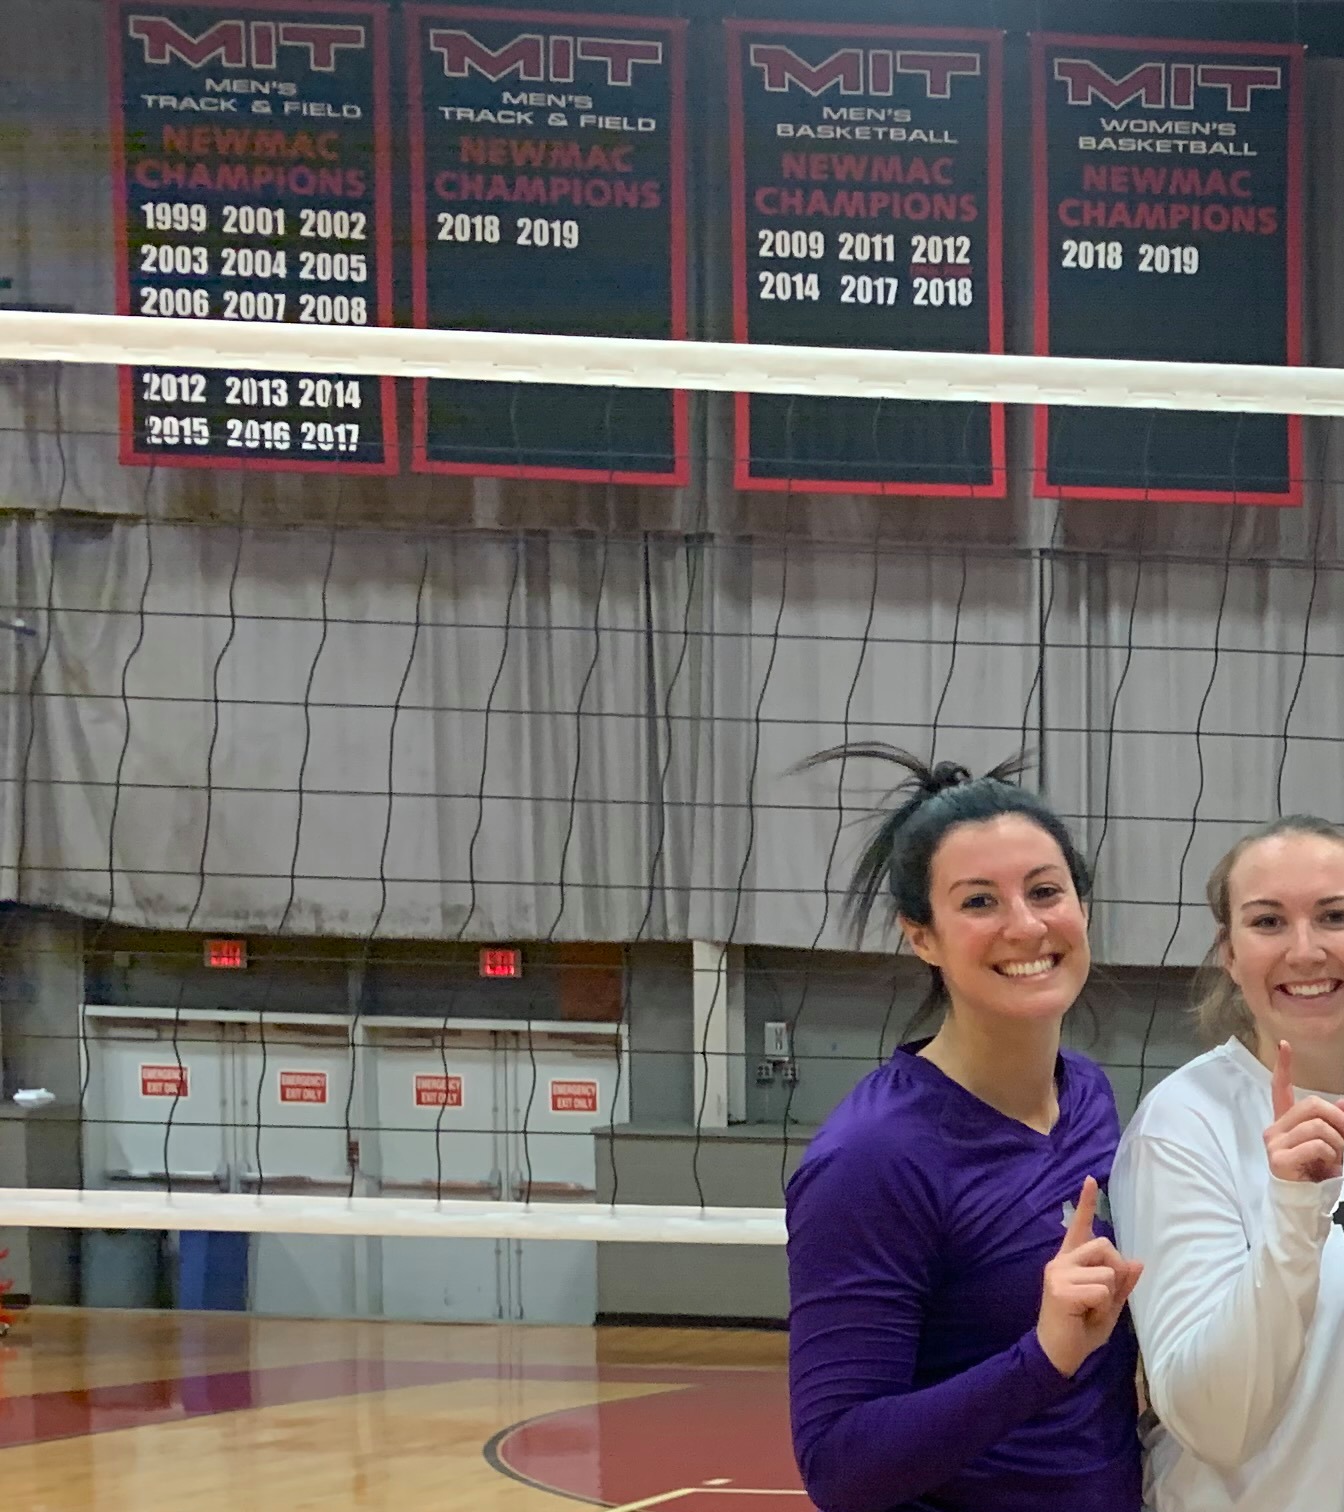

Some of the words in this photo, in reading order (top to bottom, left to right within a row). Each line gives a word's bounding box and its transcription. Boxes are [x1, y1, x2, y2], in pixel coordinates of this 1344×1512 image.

[128, 16, 365, 72] MIT
[429, 29, 662, 86] MIT
[205, 78, 297, 97] MEN'S
[750, 44, 980, 99] MIT
[1054, 58, 1281, 112] MIT
[141, 95, 237, 113] TRACK
[251, 100, 273, 114] &
[283, 101, 362, 119] FIELD
[501, 91, 593, 109] MEN'S
[822, 107, 912, 122] MEN'S
[438, 106, 534, 125] TRACK
[548, 113, 568, 126] &
[580, 114, 656, 132] FIELD
[776, 123, 958, 144] BASKETBALL
[1100, 118, 1237, 136] WOMEN'S
[161, 125, 339, 161] NEWMAC
[460, 137, 634, 172] NEWMAC
[1078, 136, 1258, 157] BASKETBALL
[134, 160, 366, 197] CHAMPIONS
[781, 151, 954, 185] NEWMAC
[1082, 165, 1252, 198] NEWMAC
[434, 171, 661, 209] CHAMPIONS
[754, 186, 978, 223] CHAMPIONS
[140, 202, 208, 234] 1999
[222, 205, 286, 237] 2001
[300, 209, 366, 240] 2002
[437, 213, 500, 244] 2018
[516, 218, 580, 249] 2019
[1058, 199, 1278, 235] CHAMPIONS
[140, 245, 209, 276] 2003
[221, 248, 287, 279] 2004
[299, 252, 367, 283] 2005
[758, 230, 825, 260] 2009
[838, 233, 895, 262] 2011
[911, 235, 970, 264] 2012
[1062, 240, 1123, 271] 2018
[1138, 244, 1199, 275] 2019
[140, 287, 209, 318] 2006
[223, 291, 287, 322] 2007
[299, 294, 367, 325] 2008
[759, 272, 820, 302] 2014
[840, 276, 899, 305] 2017
[913, 277, 972, 306] 2018
[143, 373, 207, 403] 2012
[225, 377, 289, 407] 2013
[299, 379, 361, 408] 2014
[146, 416, 210, 445] 2015
[226, 419, 291, 450] 2016
[301, 422, 360, 452] 2017
